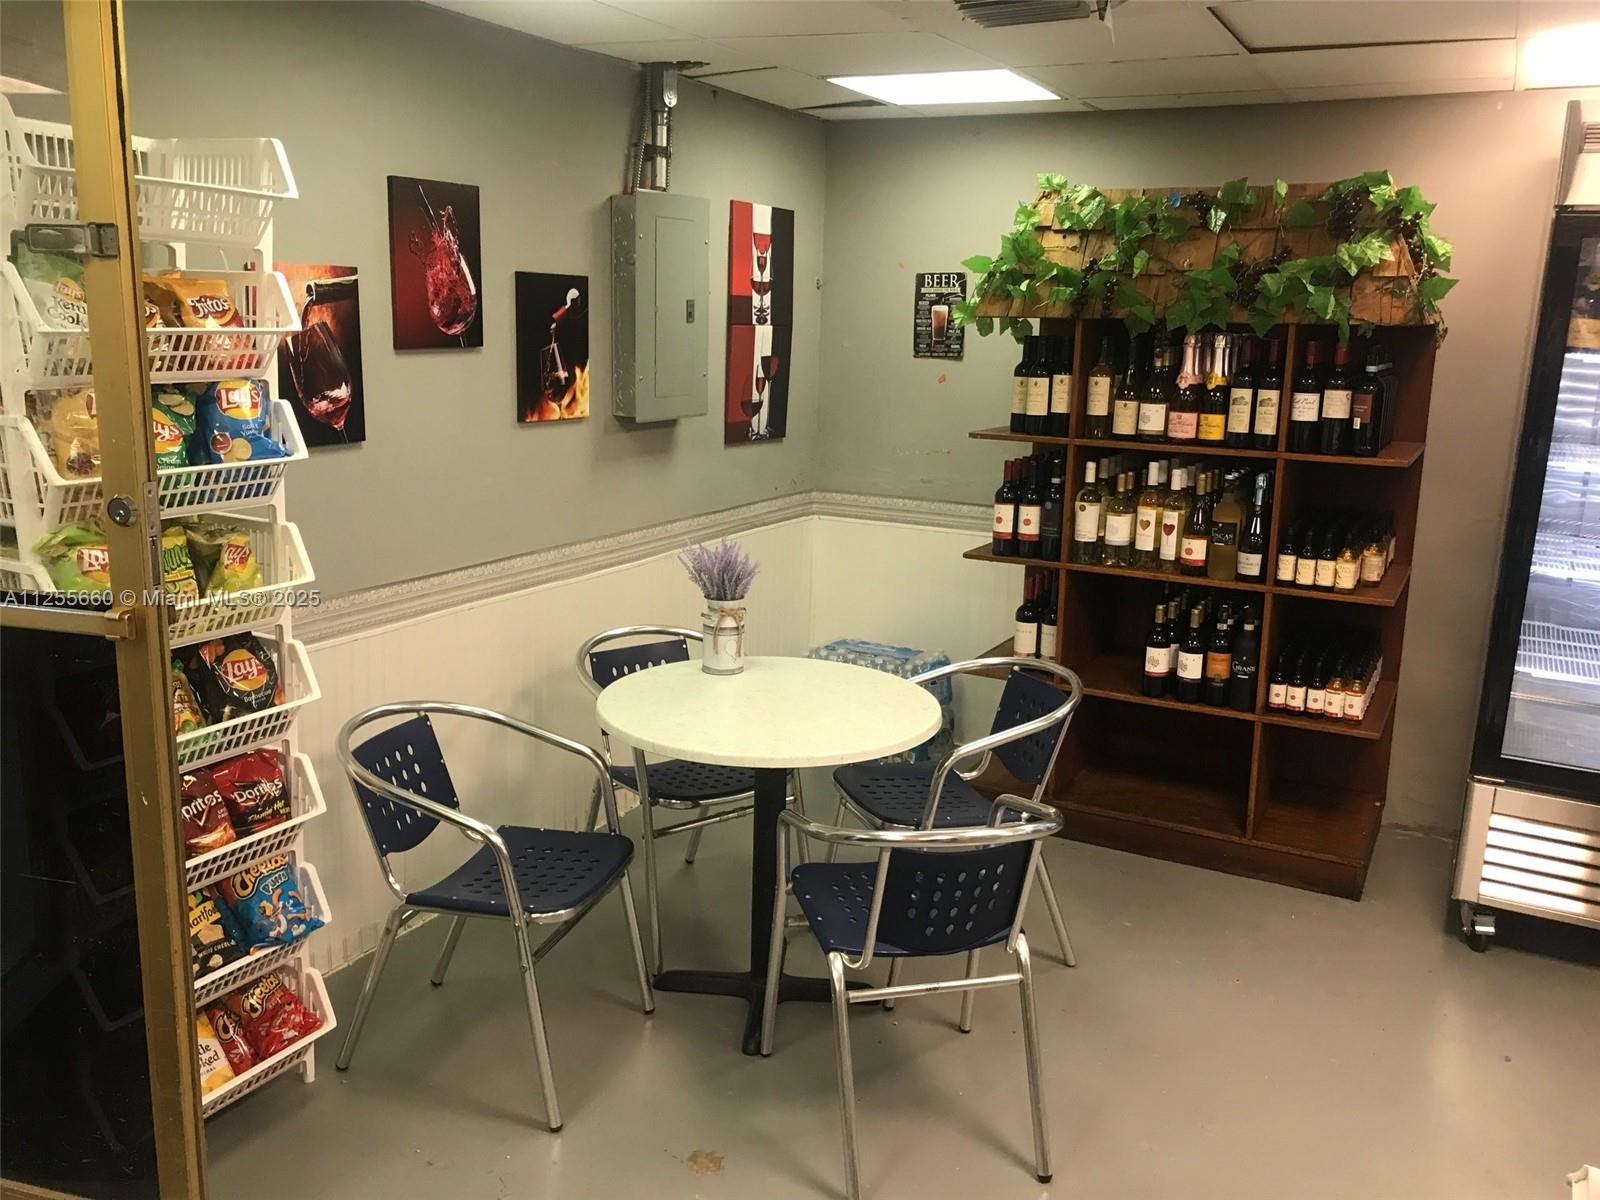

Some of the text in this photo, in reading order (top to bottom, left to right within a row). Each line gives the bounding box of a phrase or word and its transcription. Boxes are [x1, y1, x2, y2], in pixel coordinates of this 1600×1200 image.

[925, 274, 959, 288] BEER
[187, 297, 230, 318] Fritos
[231, 777, 283, 804] Doritos
[191, 904, 218, 930] artfo
